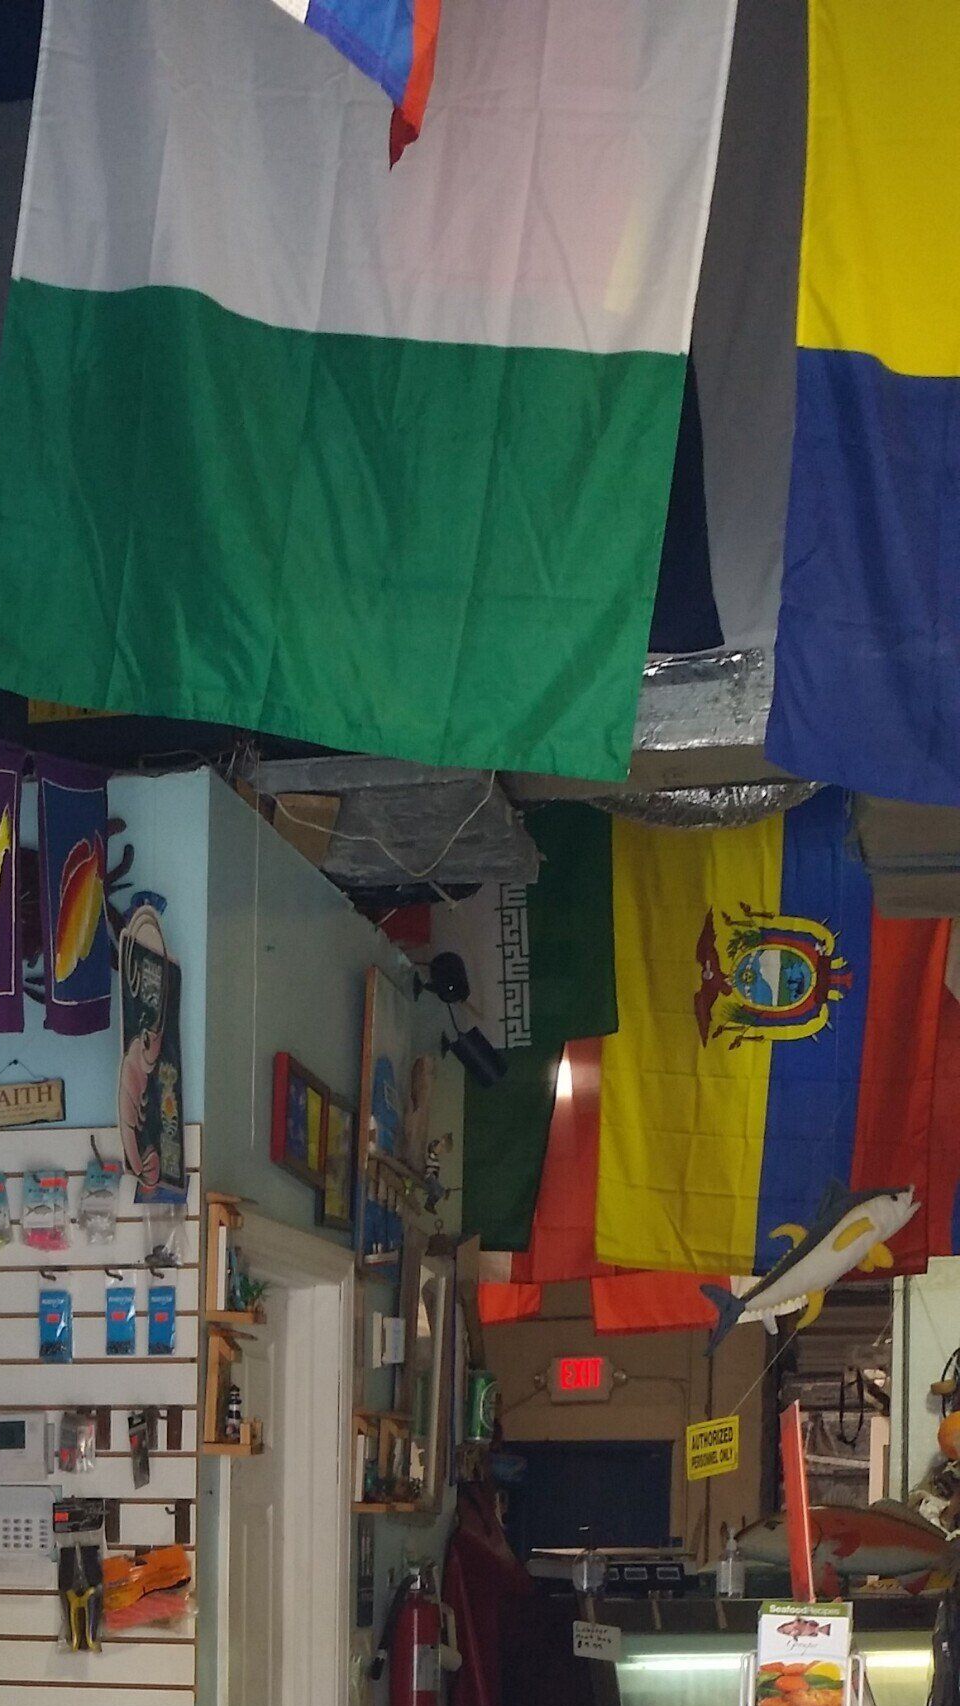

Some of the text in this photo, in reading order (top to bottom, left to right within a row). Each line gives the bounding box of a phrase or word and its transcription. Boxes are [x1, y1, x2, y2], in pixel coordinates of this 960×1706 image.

[561, 1358, 601, 1390] EXIT
[691, 1426, 733, 1450] AUTHORIZED
[692, 1448, 733, 1469] PERSONNEL ONLY
